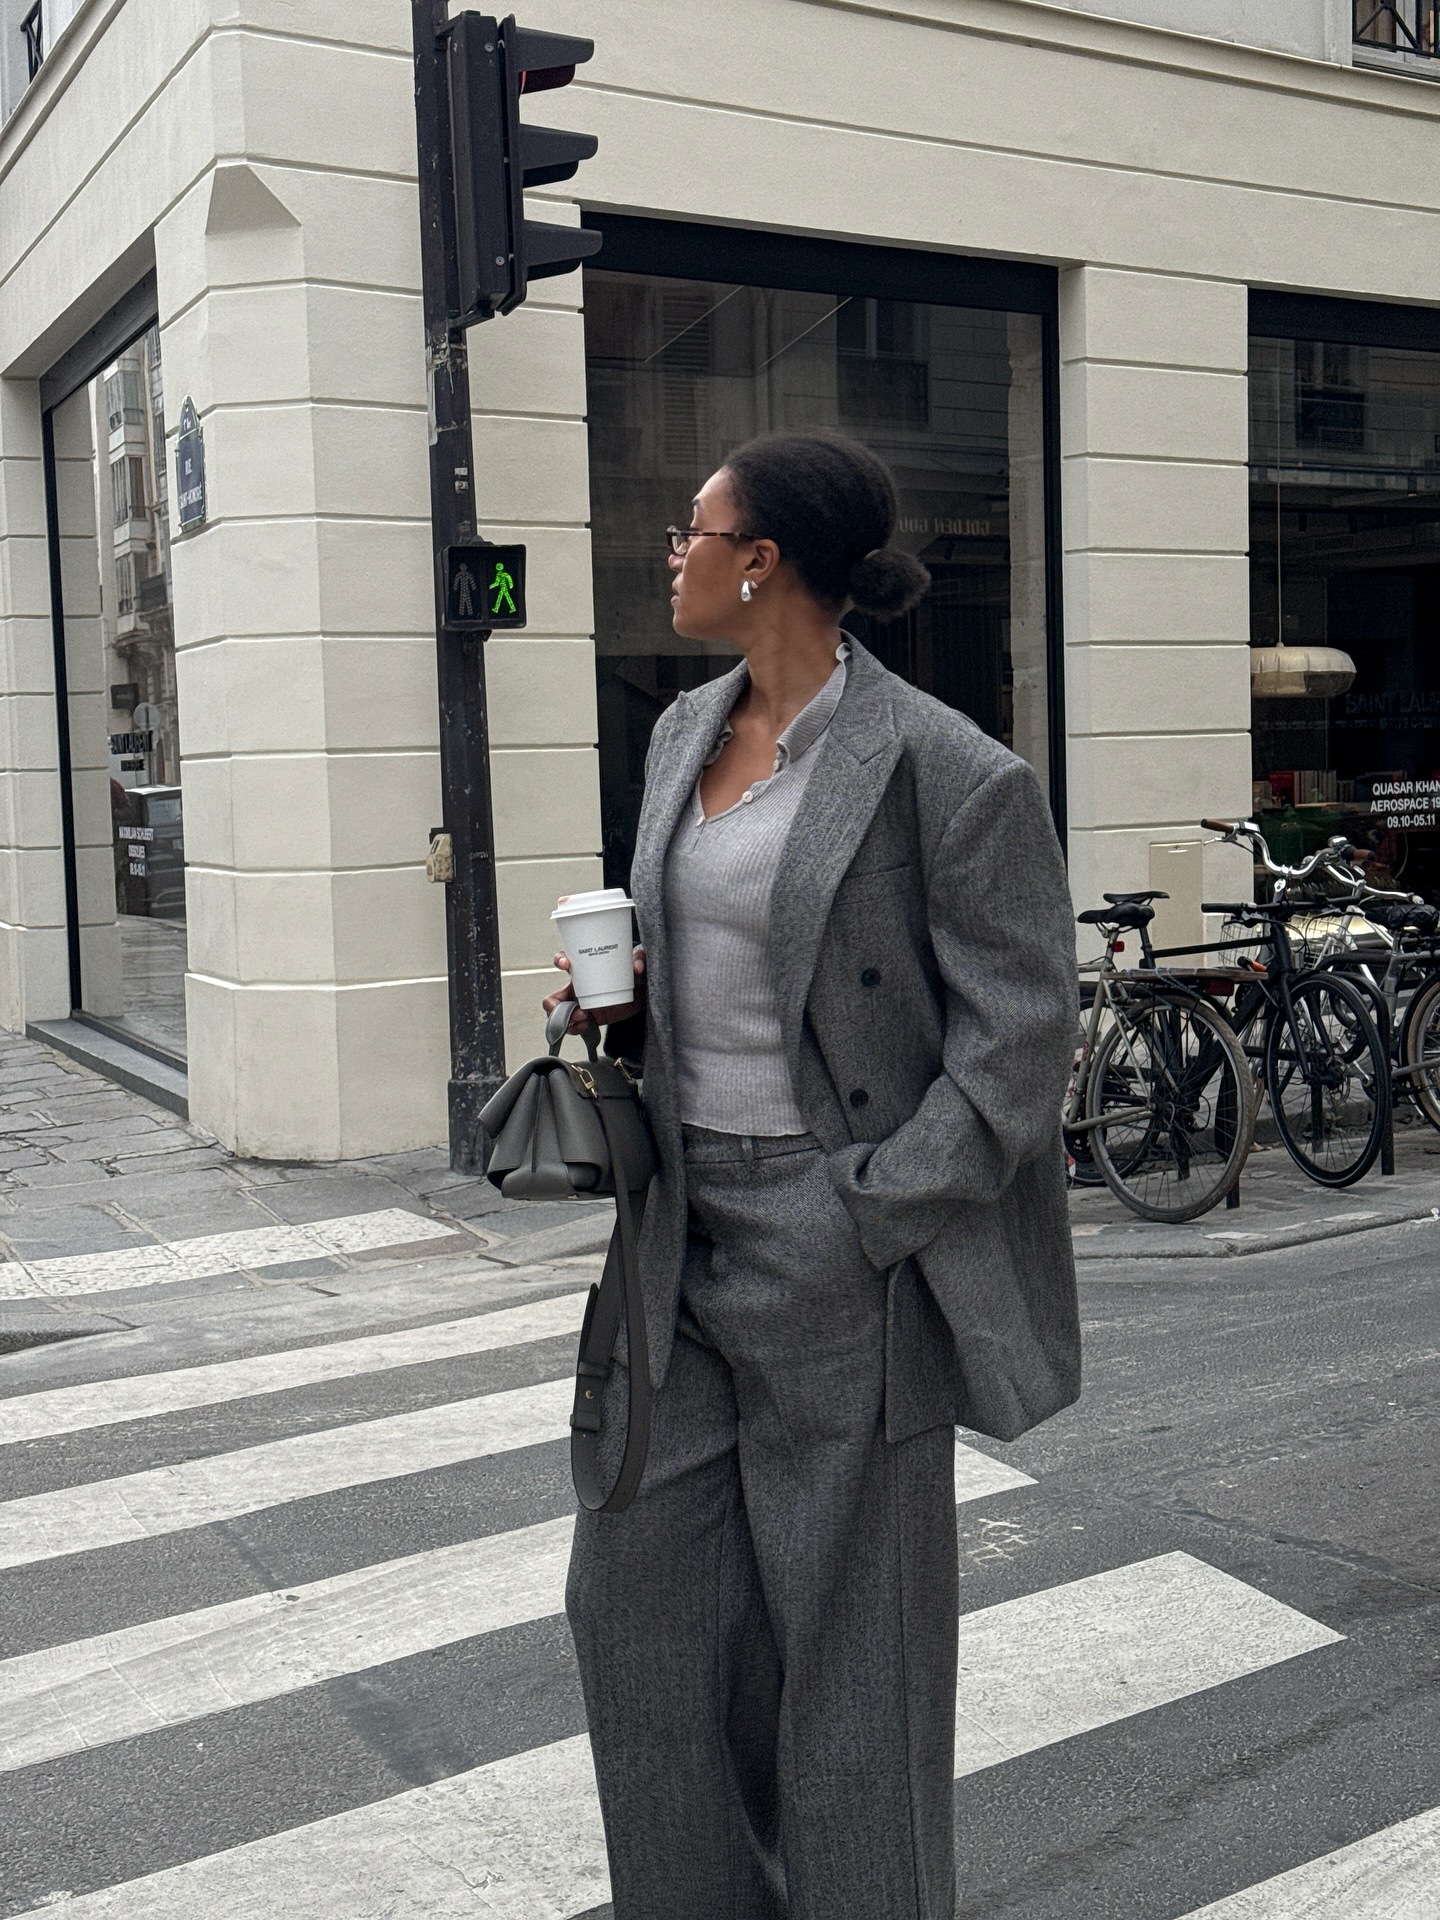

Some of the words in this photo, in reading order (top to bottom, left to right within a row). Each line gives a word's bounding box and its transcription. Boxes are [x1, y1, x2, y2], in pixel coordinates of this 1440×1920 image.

[1372, 781, 1414, 796] QUASAR
[1370, 797, 1429, 813] AEROSPACE
[1387, 813, 1436, 829] 09.10-05.11
[594, 944, 618, 952] LAURENT
